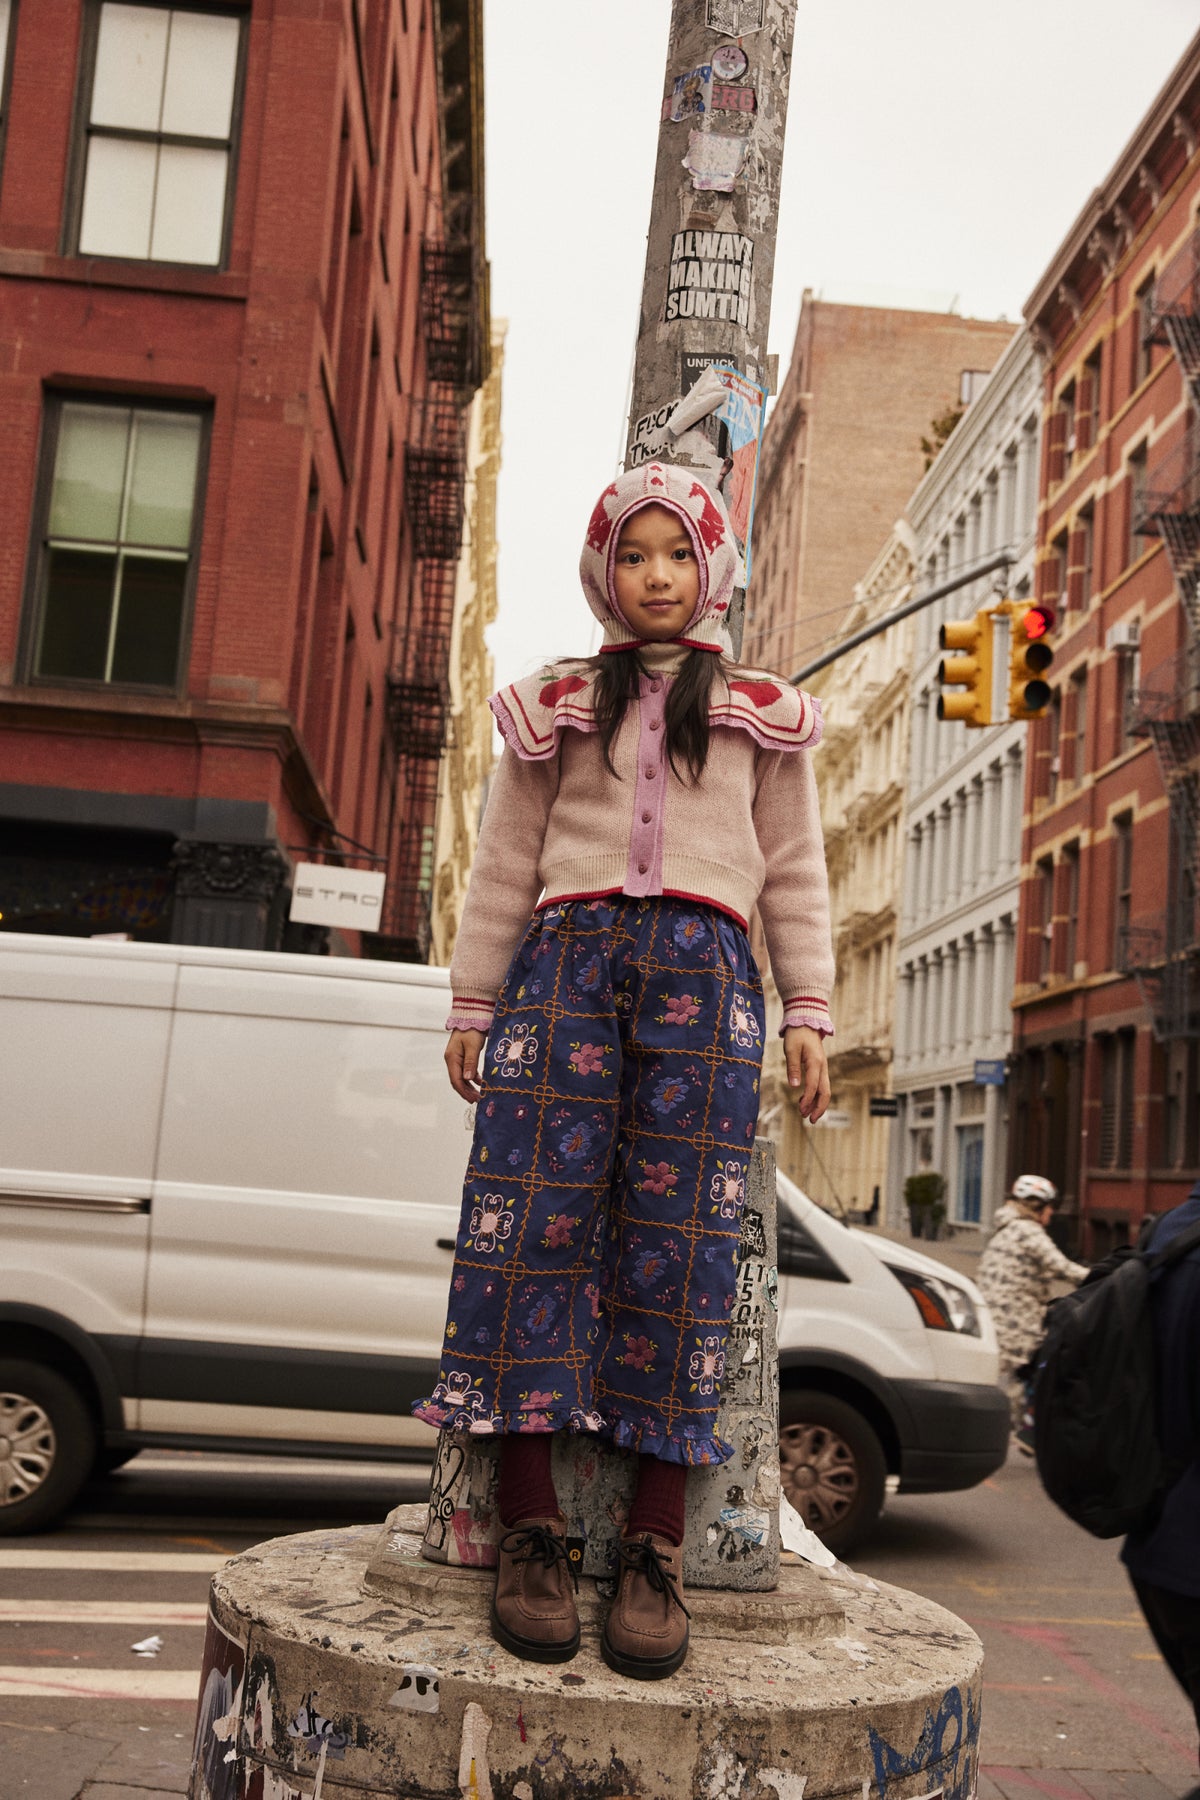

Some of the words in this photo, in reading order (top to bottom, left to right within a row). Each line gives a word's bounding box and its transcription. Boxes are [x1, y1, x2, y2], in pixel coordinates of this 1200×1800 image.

[711, 85, 756, 112] ERG
[669, 260, 750, 297] MAKING
[667, 290, 749, 327] SUMTIN
[713, 391, 761, 439] EN
[296, 886, 380, 907] ETRO
